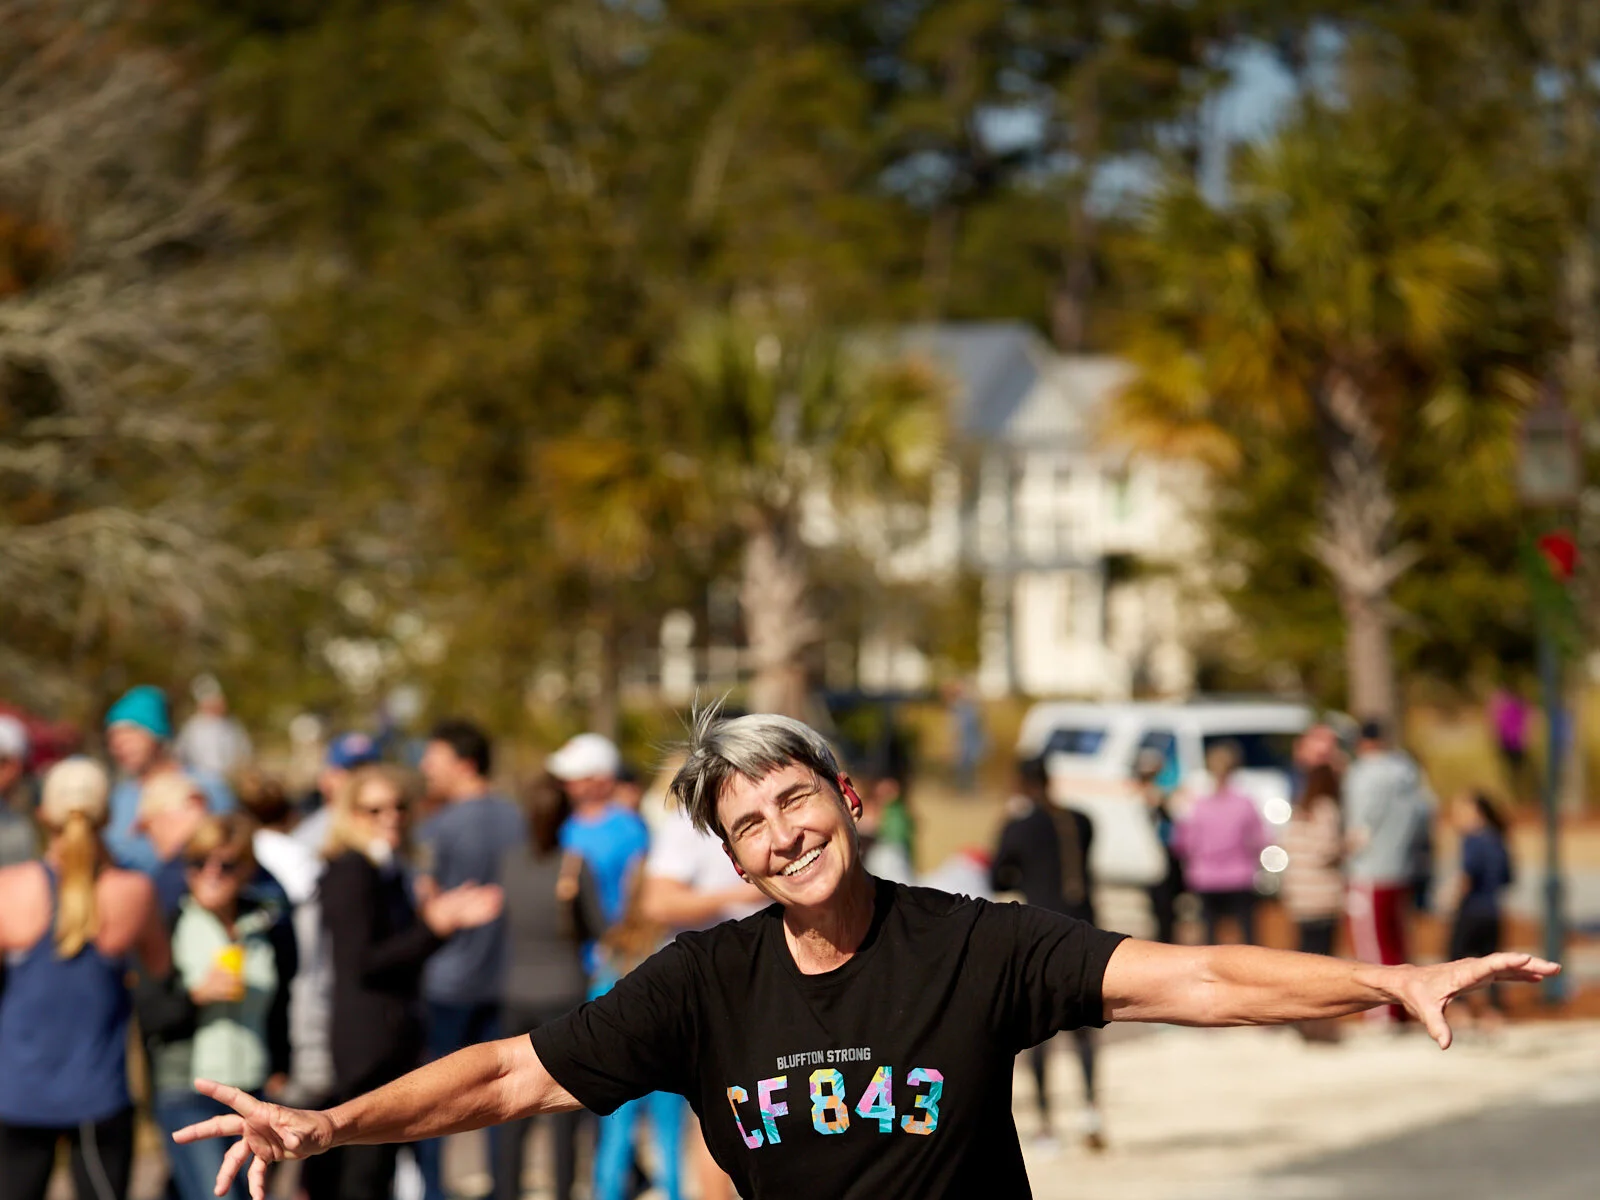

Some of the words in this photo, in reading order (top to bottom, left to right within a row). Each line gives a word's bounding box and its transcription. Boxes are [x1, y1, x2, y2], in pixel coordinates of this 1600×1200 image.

[777, 1050, 825, 1070] BLUFFTON
[826, 1047, 871, 1063] STRONG
[727, 1075, 789, 1149] CF
[808, 1066, 944, 1135] 843
